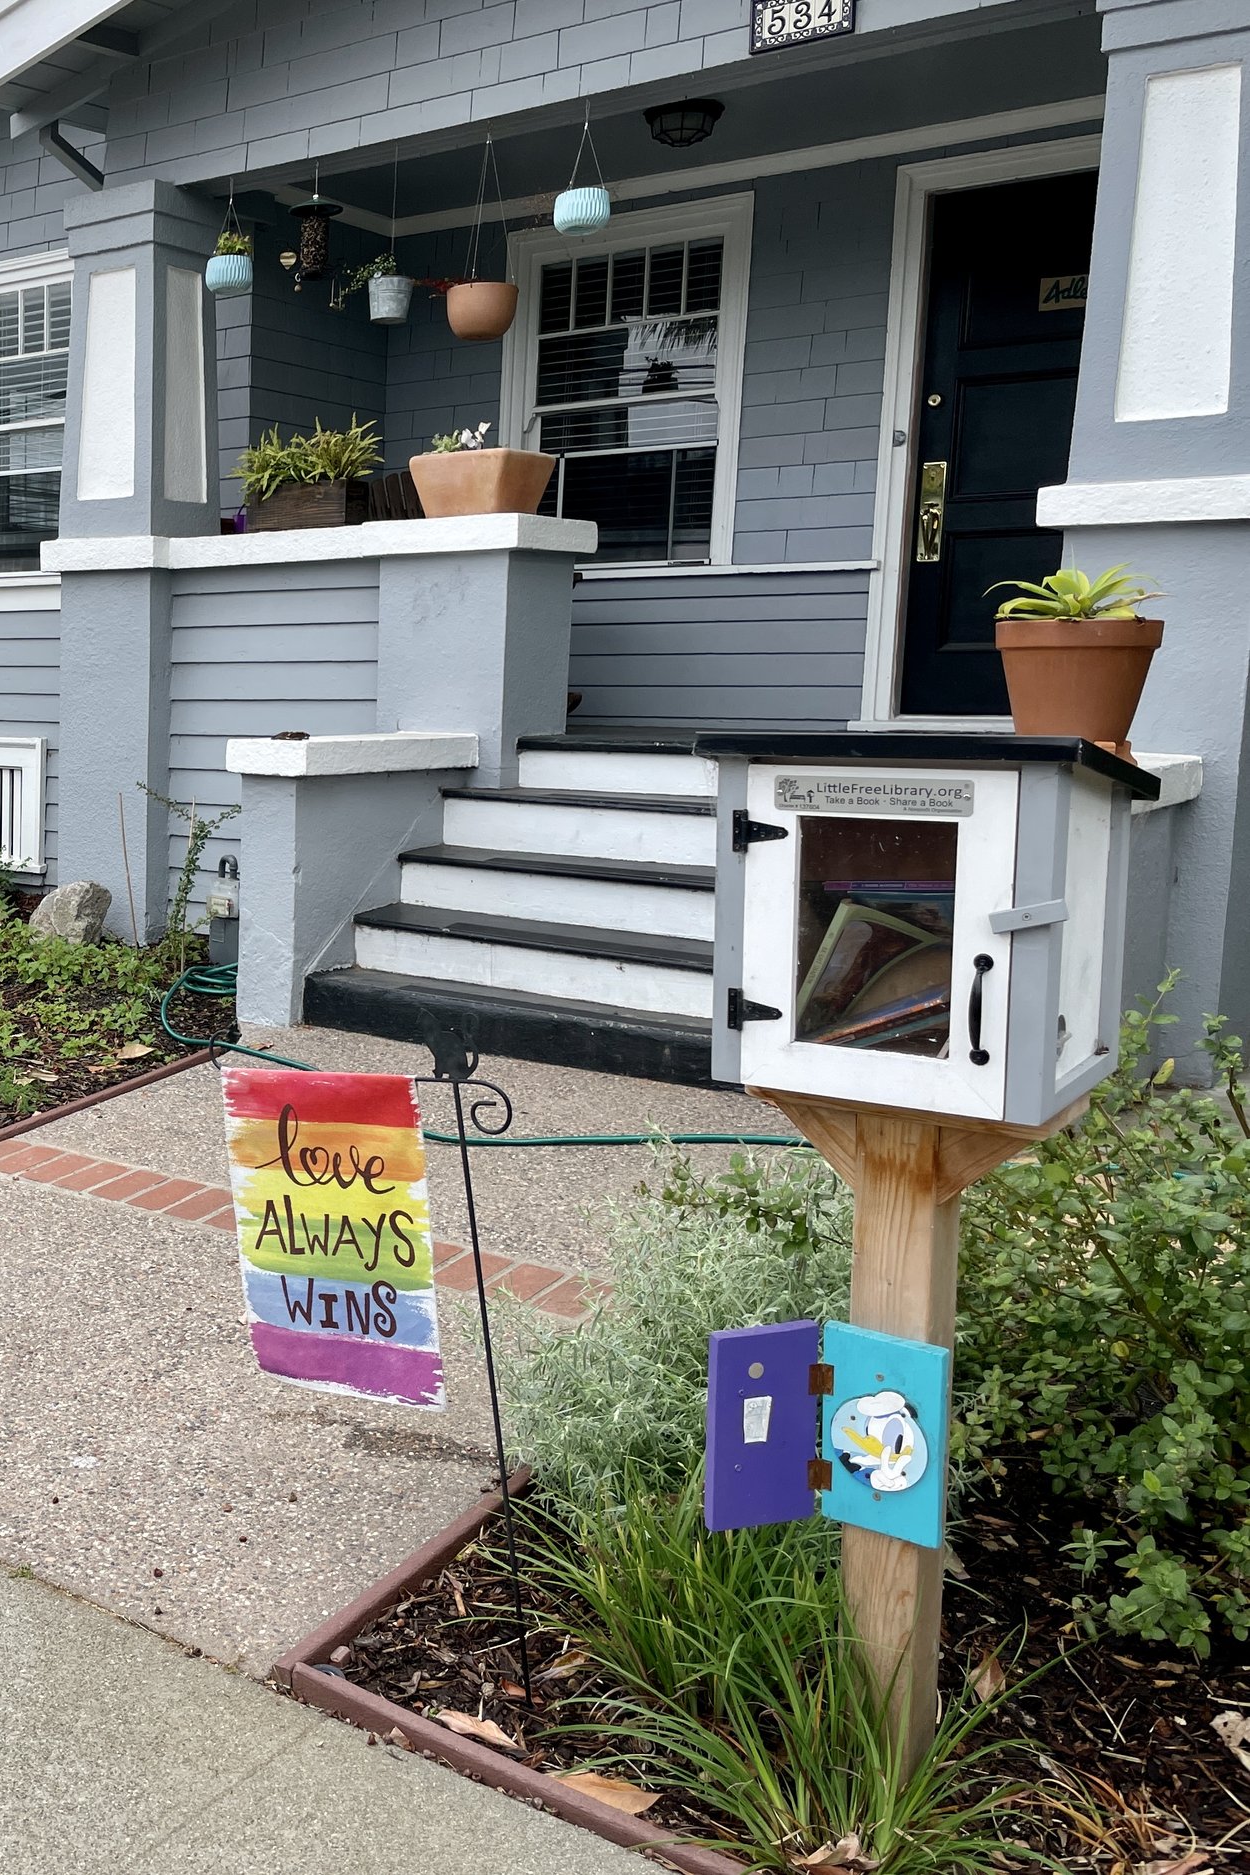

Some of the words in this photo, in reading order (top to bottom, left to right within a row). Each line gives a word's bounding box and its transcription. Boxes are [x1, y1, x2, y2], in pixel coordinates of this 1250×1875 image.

[768, 0, 837, 35] 534
[816, 782, 963, 800] LittleFreeLibrary.org
[825, 795, 845, 804] Take
[857, 797, 880, 805] Book
[889, 797, 917, 806] Share
[929, 798, 953, 807] Book
[255, 1104, 395, 1194] love
[255, 1194, 416, 1271] ALWAYS
[281, 1275, 397, 1338] WINS
